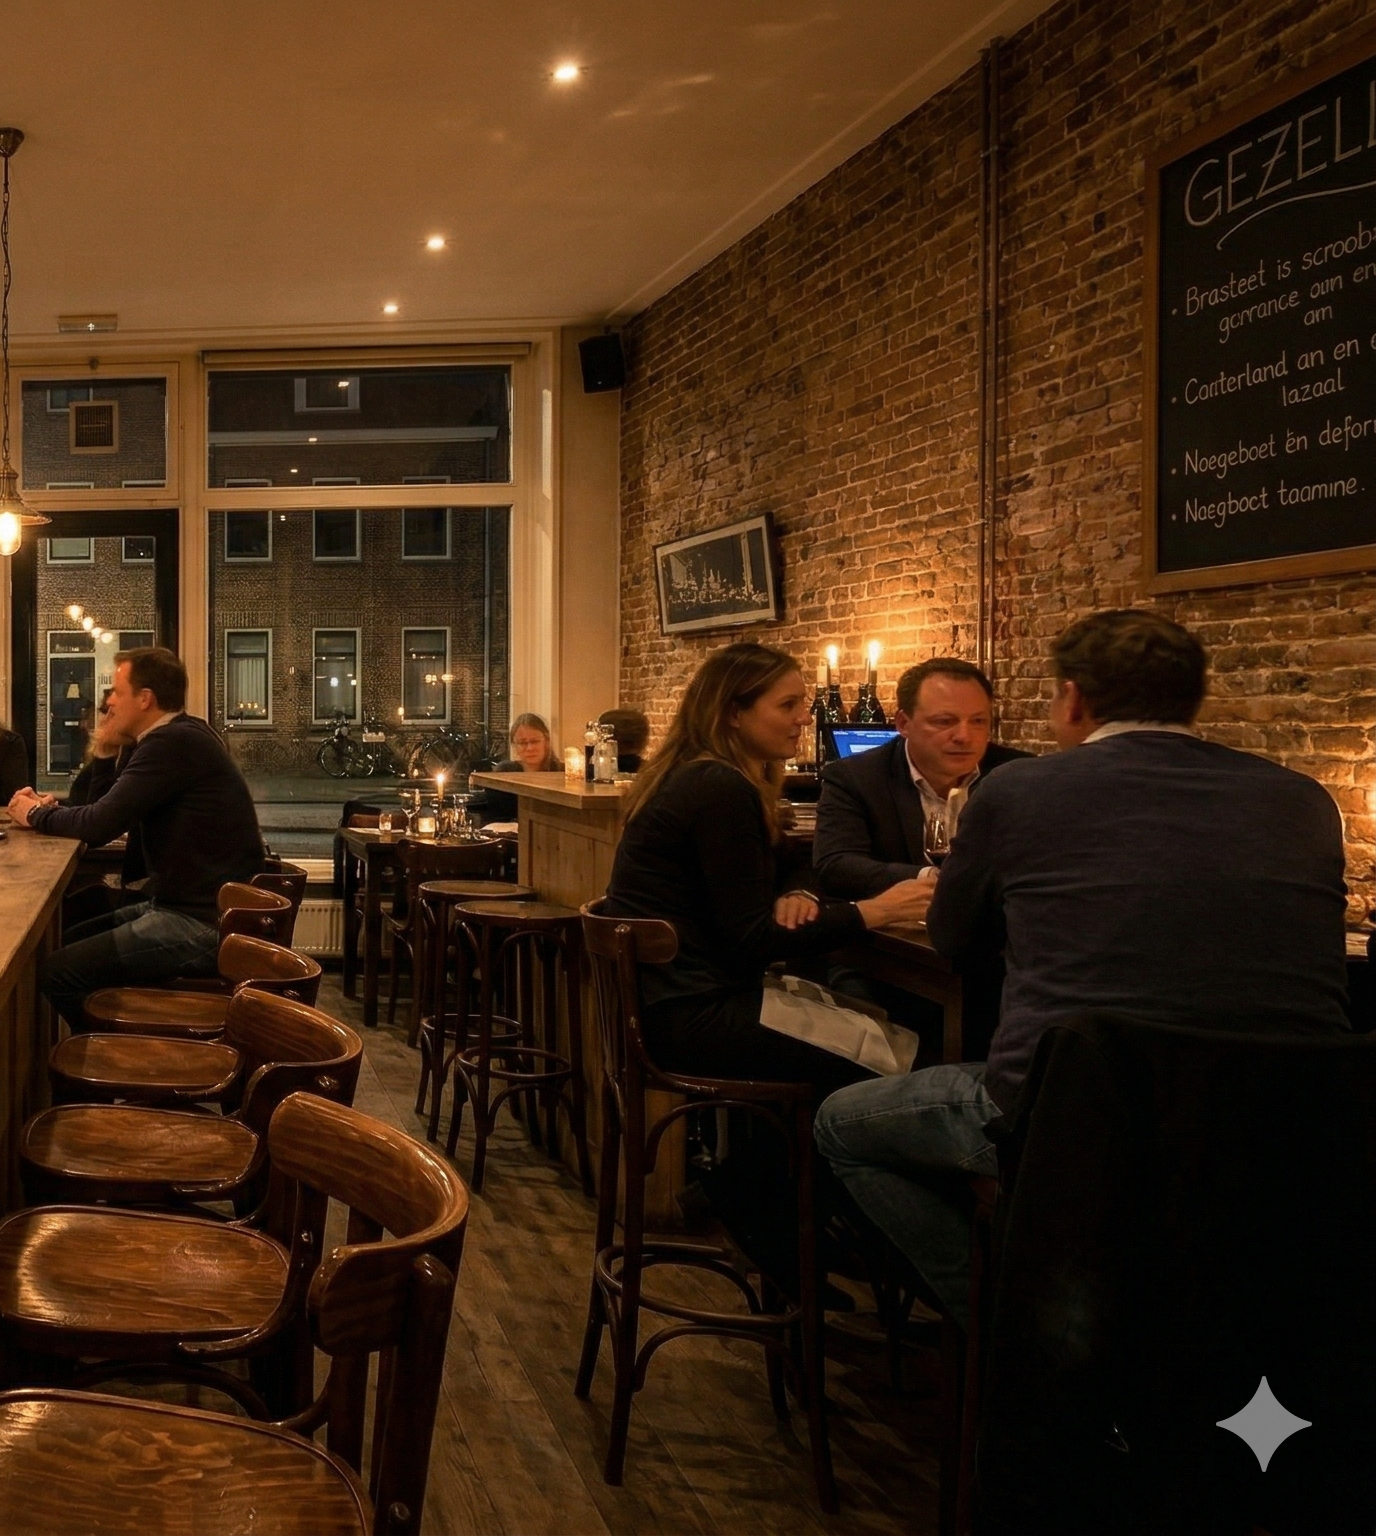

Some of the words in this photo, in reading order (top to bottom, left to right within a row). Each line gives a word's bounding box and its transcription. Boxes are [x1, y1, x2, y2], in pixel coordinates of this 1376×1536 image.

[1186, 259, 1267, 316] Brasteet
[1277, 259, 1291, 281] is
[1297, 349, 1324, 371] an
[1333, 338, 1360, 361] en
